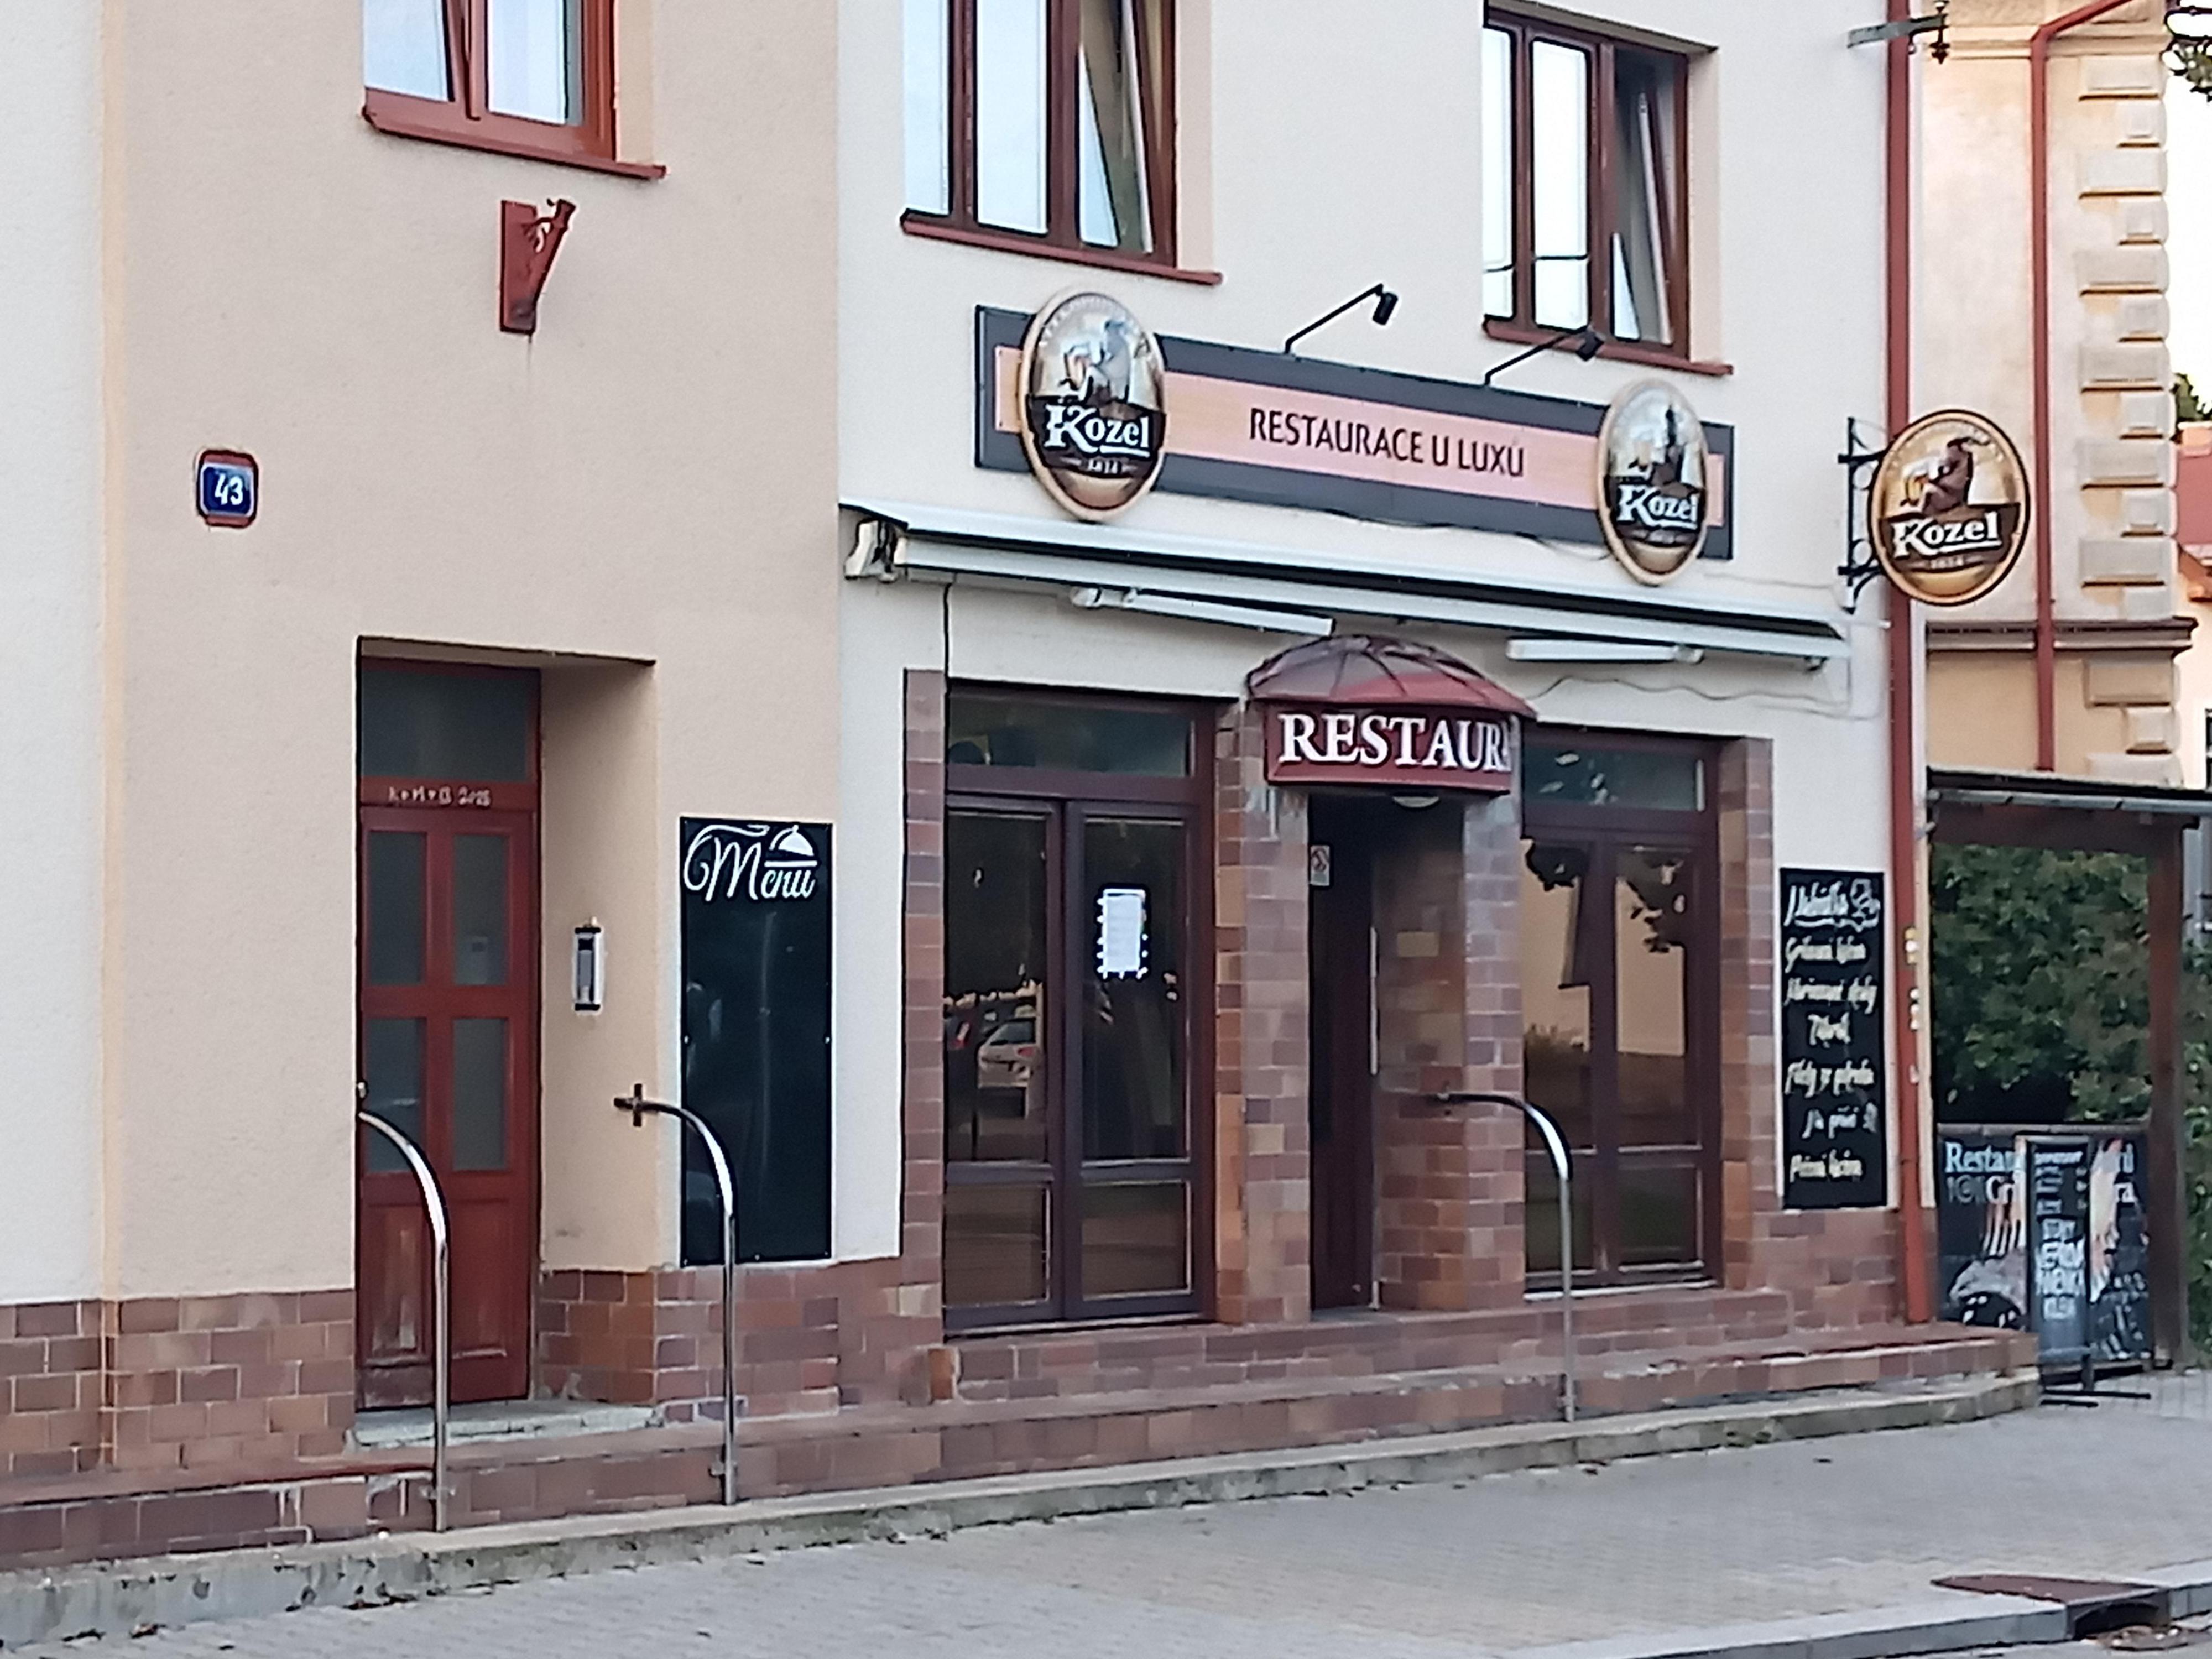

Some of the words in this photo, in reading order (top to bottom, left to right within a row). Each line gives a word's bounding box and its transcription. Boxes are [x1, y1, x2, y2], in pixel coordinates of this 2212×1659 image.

[1044, 404, 1150, 457] Kozel
[1249, 407, 1425, 464] RESTAURACE
[1432, 435, 1449, 466] U
[214, 472, 244, 505] 43
[1616, 484, 1698, 530] Kozel
[1891, 511, 2002, 558] Kozel
[683, 824, 816, 902] Menu
